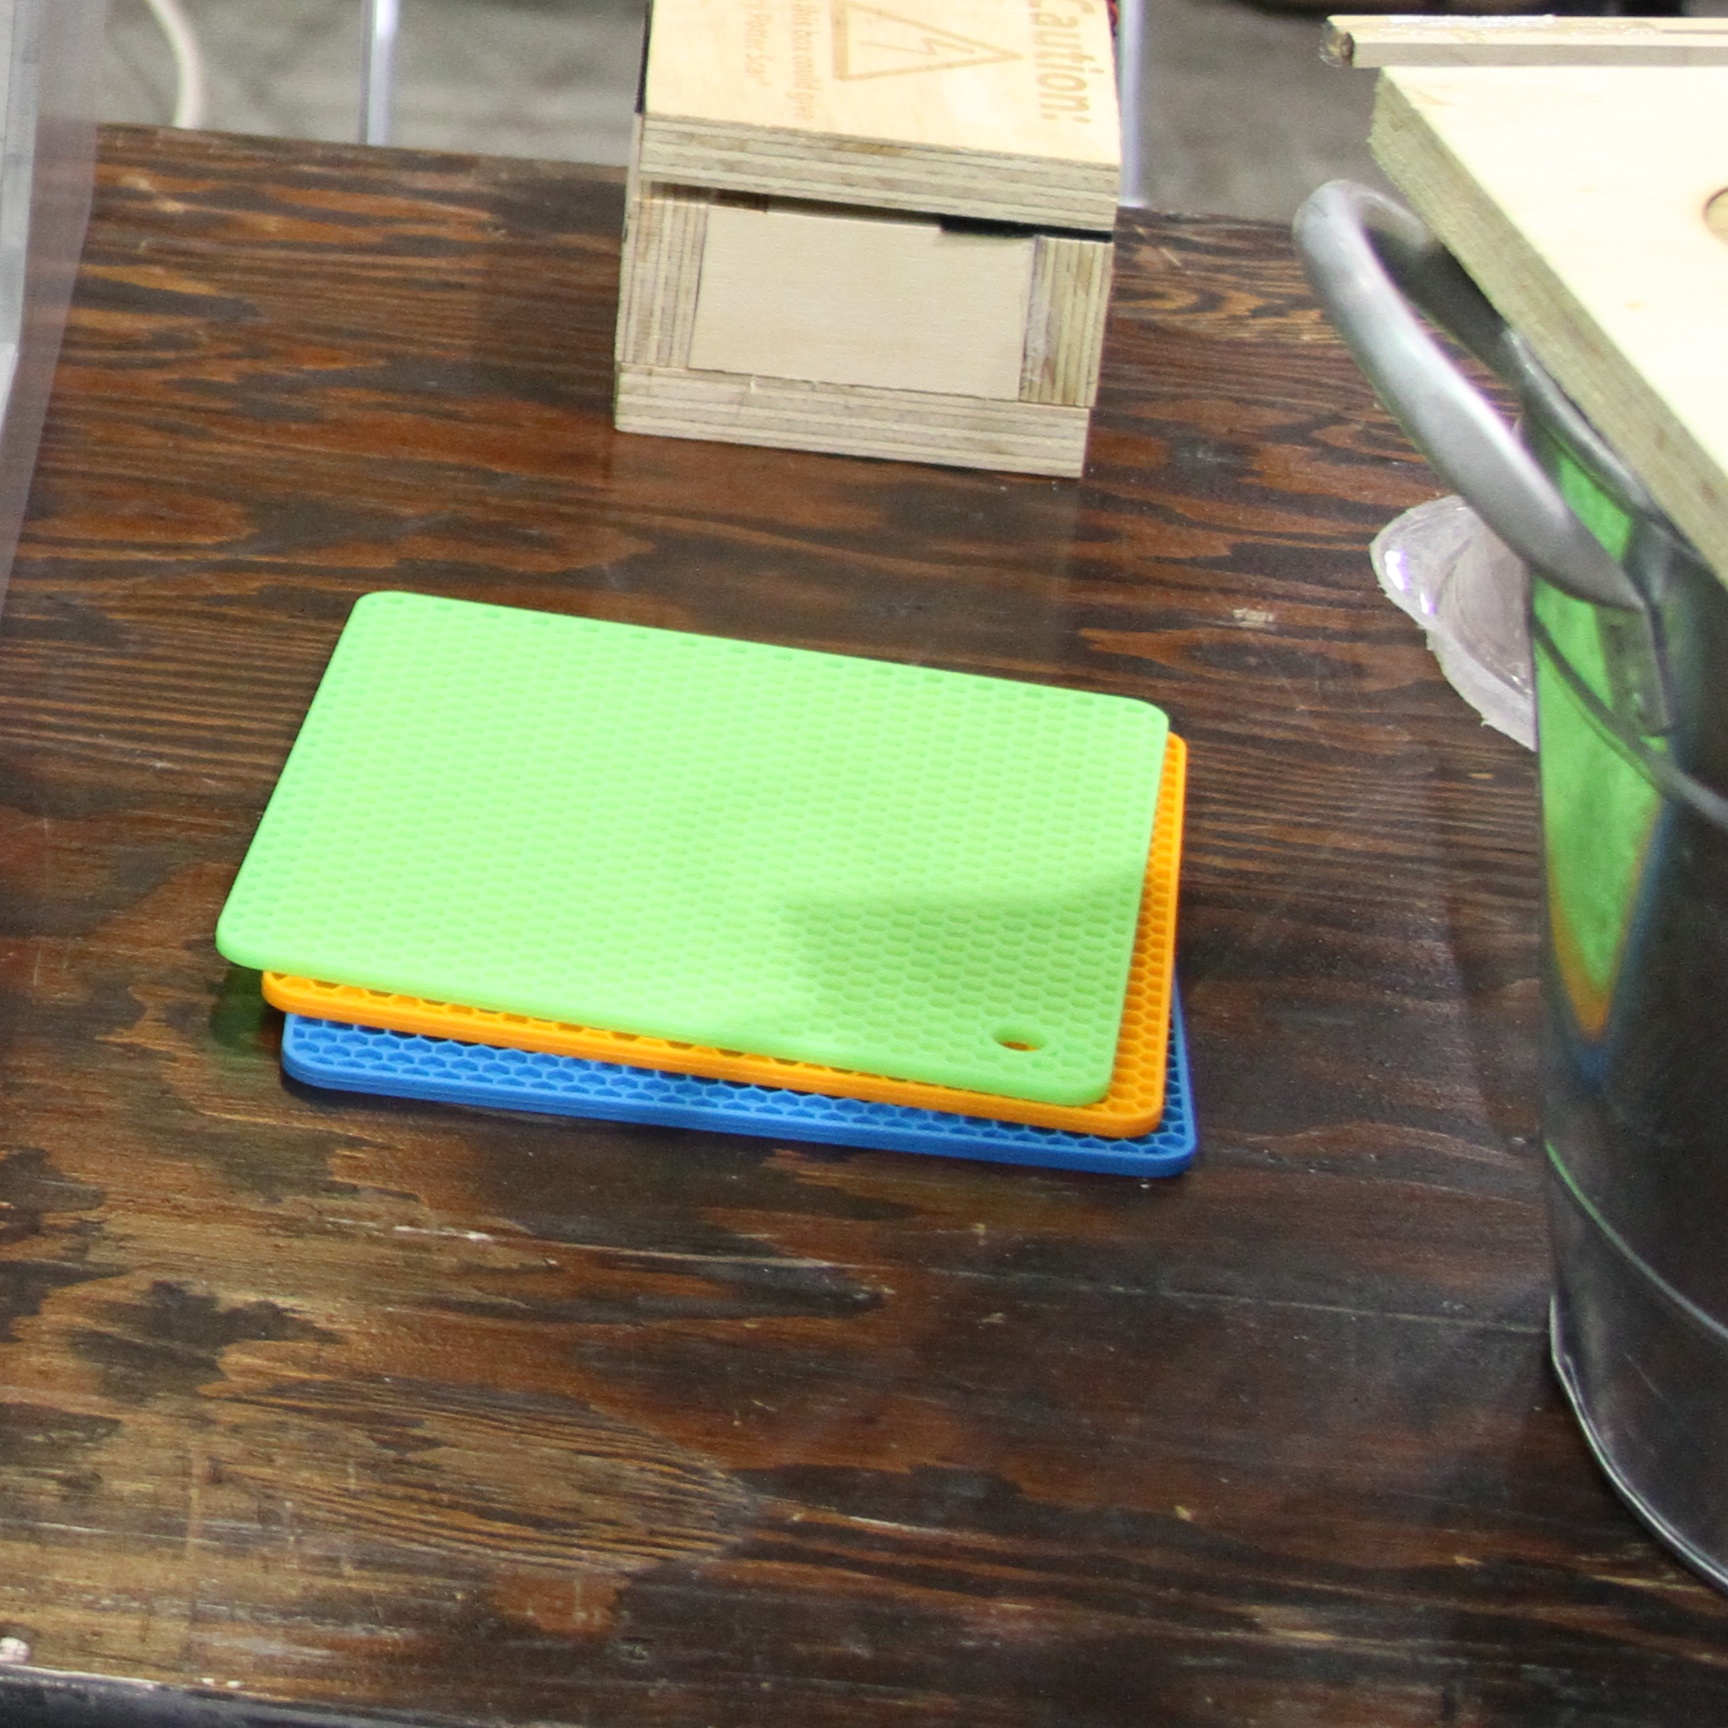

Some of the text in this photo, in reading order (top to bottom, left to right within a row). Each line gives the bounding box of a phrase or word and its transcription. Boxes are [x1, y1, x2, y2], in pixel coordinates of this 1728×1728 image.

[792, 3, 820, 26] this
[745, 12, 774, 51] Potter
[793, 29, 820, 52] box
[793, 55, 823, 90] could
[785, 91, 819, 120] give
